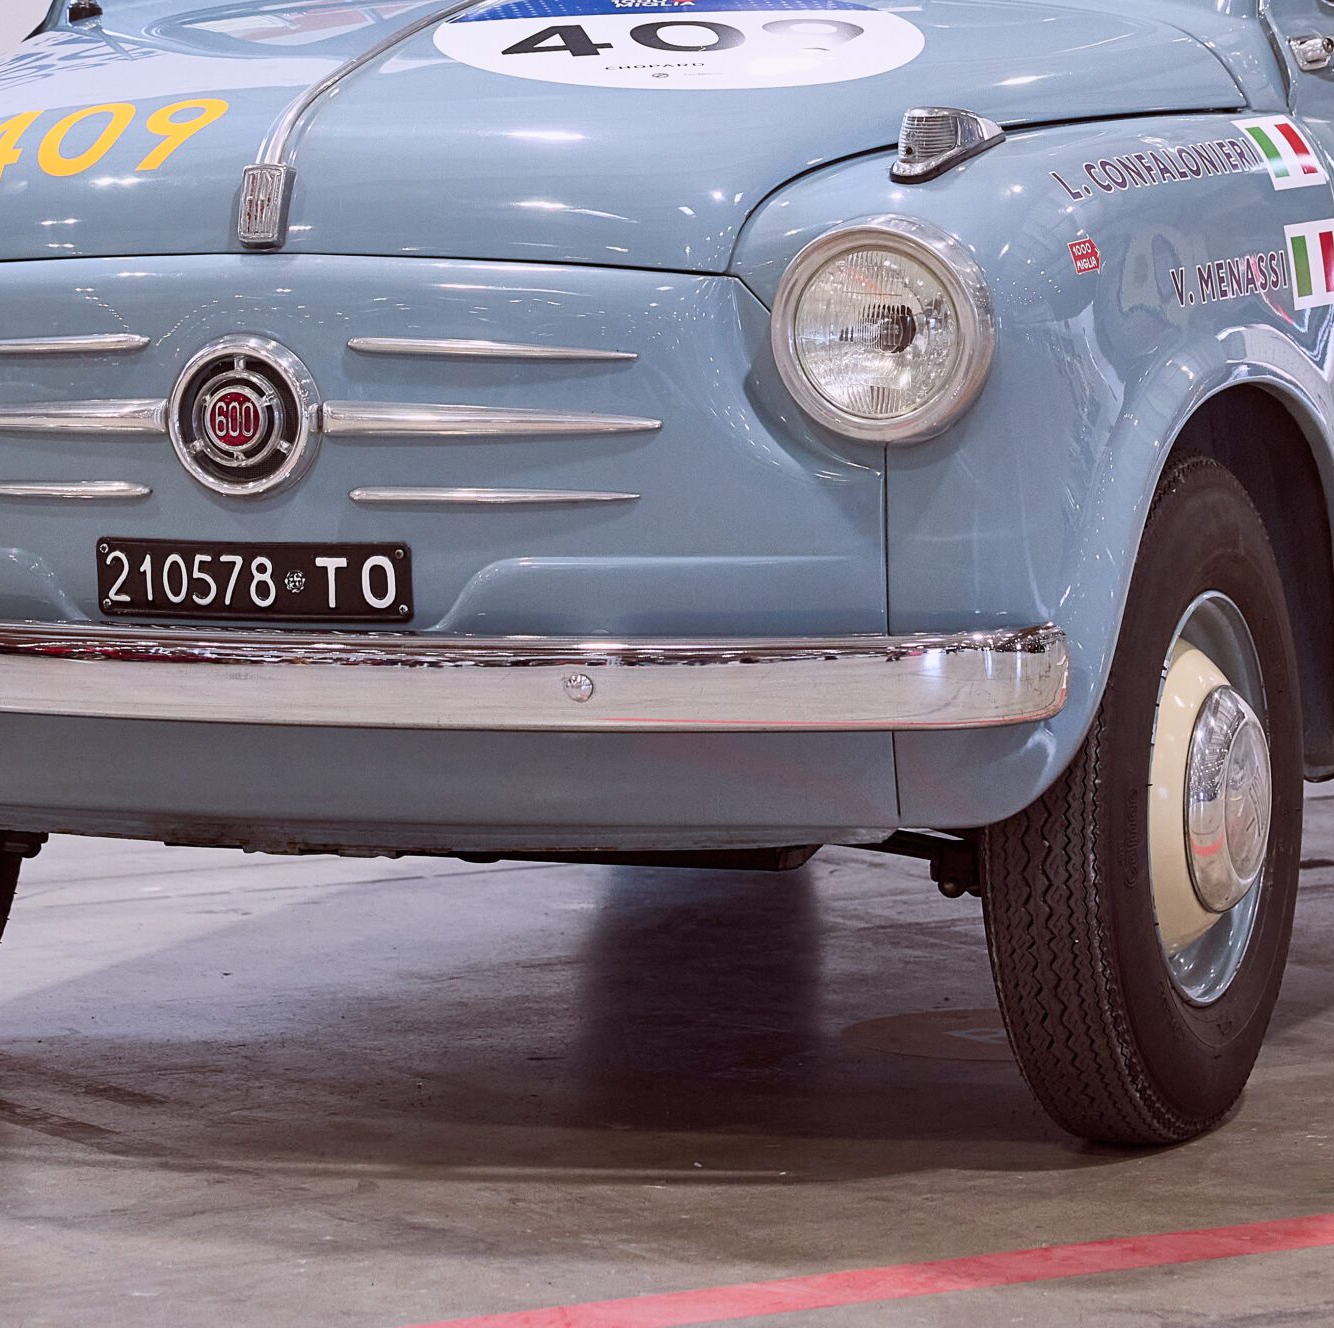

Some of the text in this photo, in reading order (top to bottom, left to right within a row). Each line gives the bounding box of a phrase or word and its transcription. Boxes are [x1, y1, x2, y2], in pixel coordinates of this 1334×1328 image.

[605, 62, 705, 70] CHOPARD
[1050, 137, 1264, 201] L. CONFALONIERI
[1073, 243, 1091, 256] 1000
[1076, 256, 1097, 271] MIGLIA
[1170, 250, 1290, 307] V. MENASSI
[215, 401, 255, 438] 600
[105, 550, 397, 610] 210578 TO
